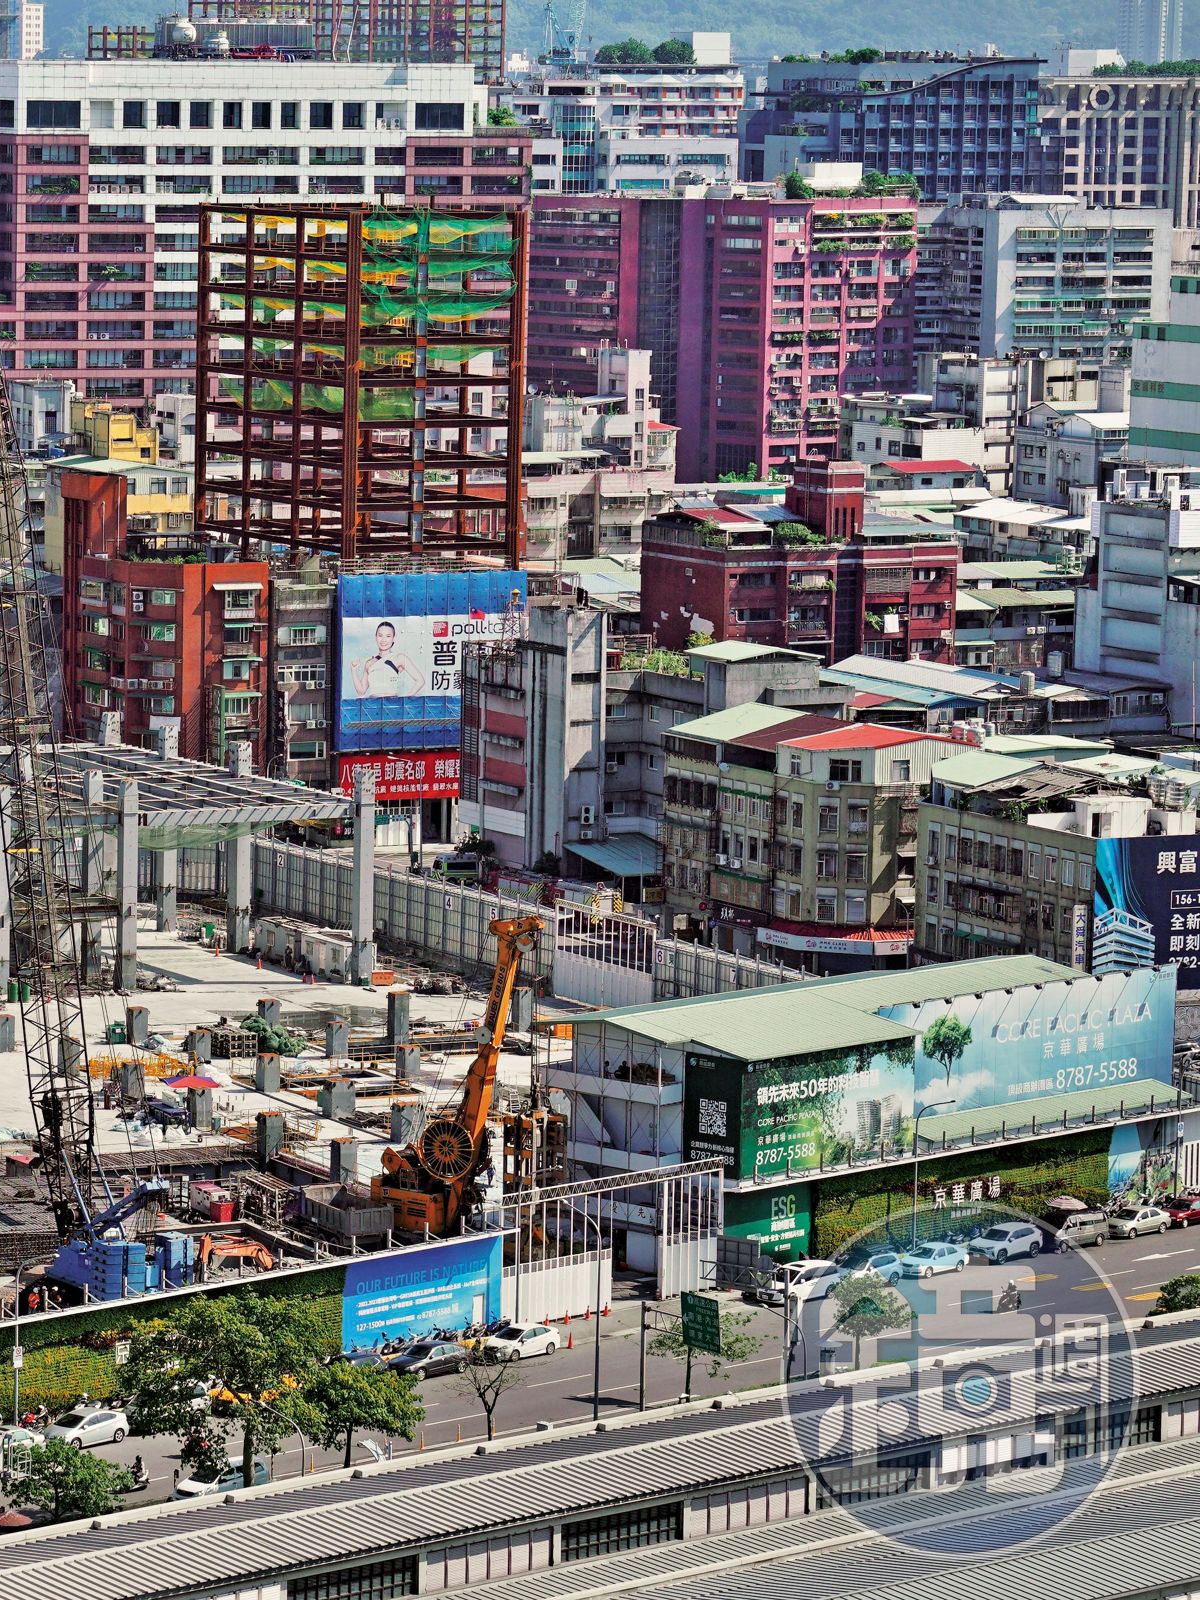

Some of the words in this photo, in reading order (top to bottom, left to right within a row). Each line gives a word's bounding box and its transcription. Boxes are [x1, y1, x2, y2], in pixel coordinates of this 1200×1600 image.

[278, 854, 284, 866] 2
[1156, 849, 1198, 875] 興富
[446, 897, 452, 909] 4
[490, 908, 497, 920] 5
[1169, 934, 1200, 952] 即刻
[657, 950, 663, 963] 6
[1043, 1032, 1105, 1060] 京華廣場
[1056, 1057, 1138, 1090] 8787-5588
[757, 1131, 786, 1146] 京華廣場
[755, 1142, 817, 1166] 8787-5588
[933, 1175, 1001, 1210] 京華廣場
[771, 1194, 796, 1221] ESG
[356, 1279, 381, 1295] OUR
[384, 1269, 427, 1289] FUTURE
[430, 1267, 440, 1281] IS
[442, 1259, 487, 1278] NATURE
